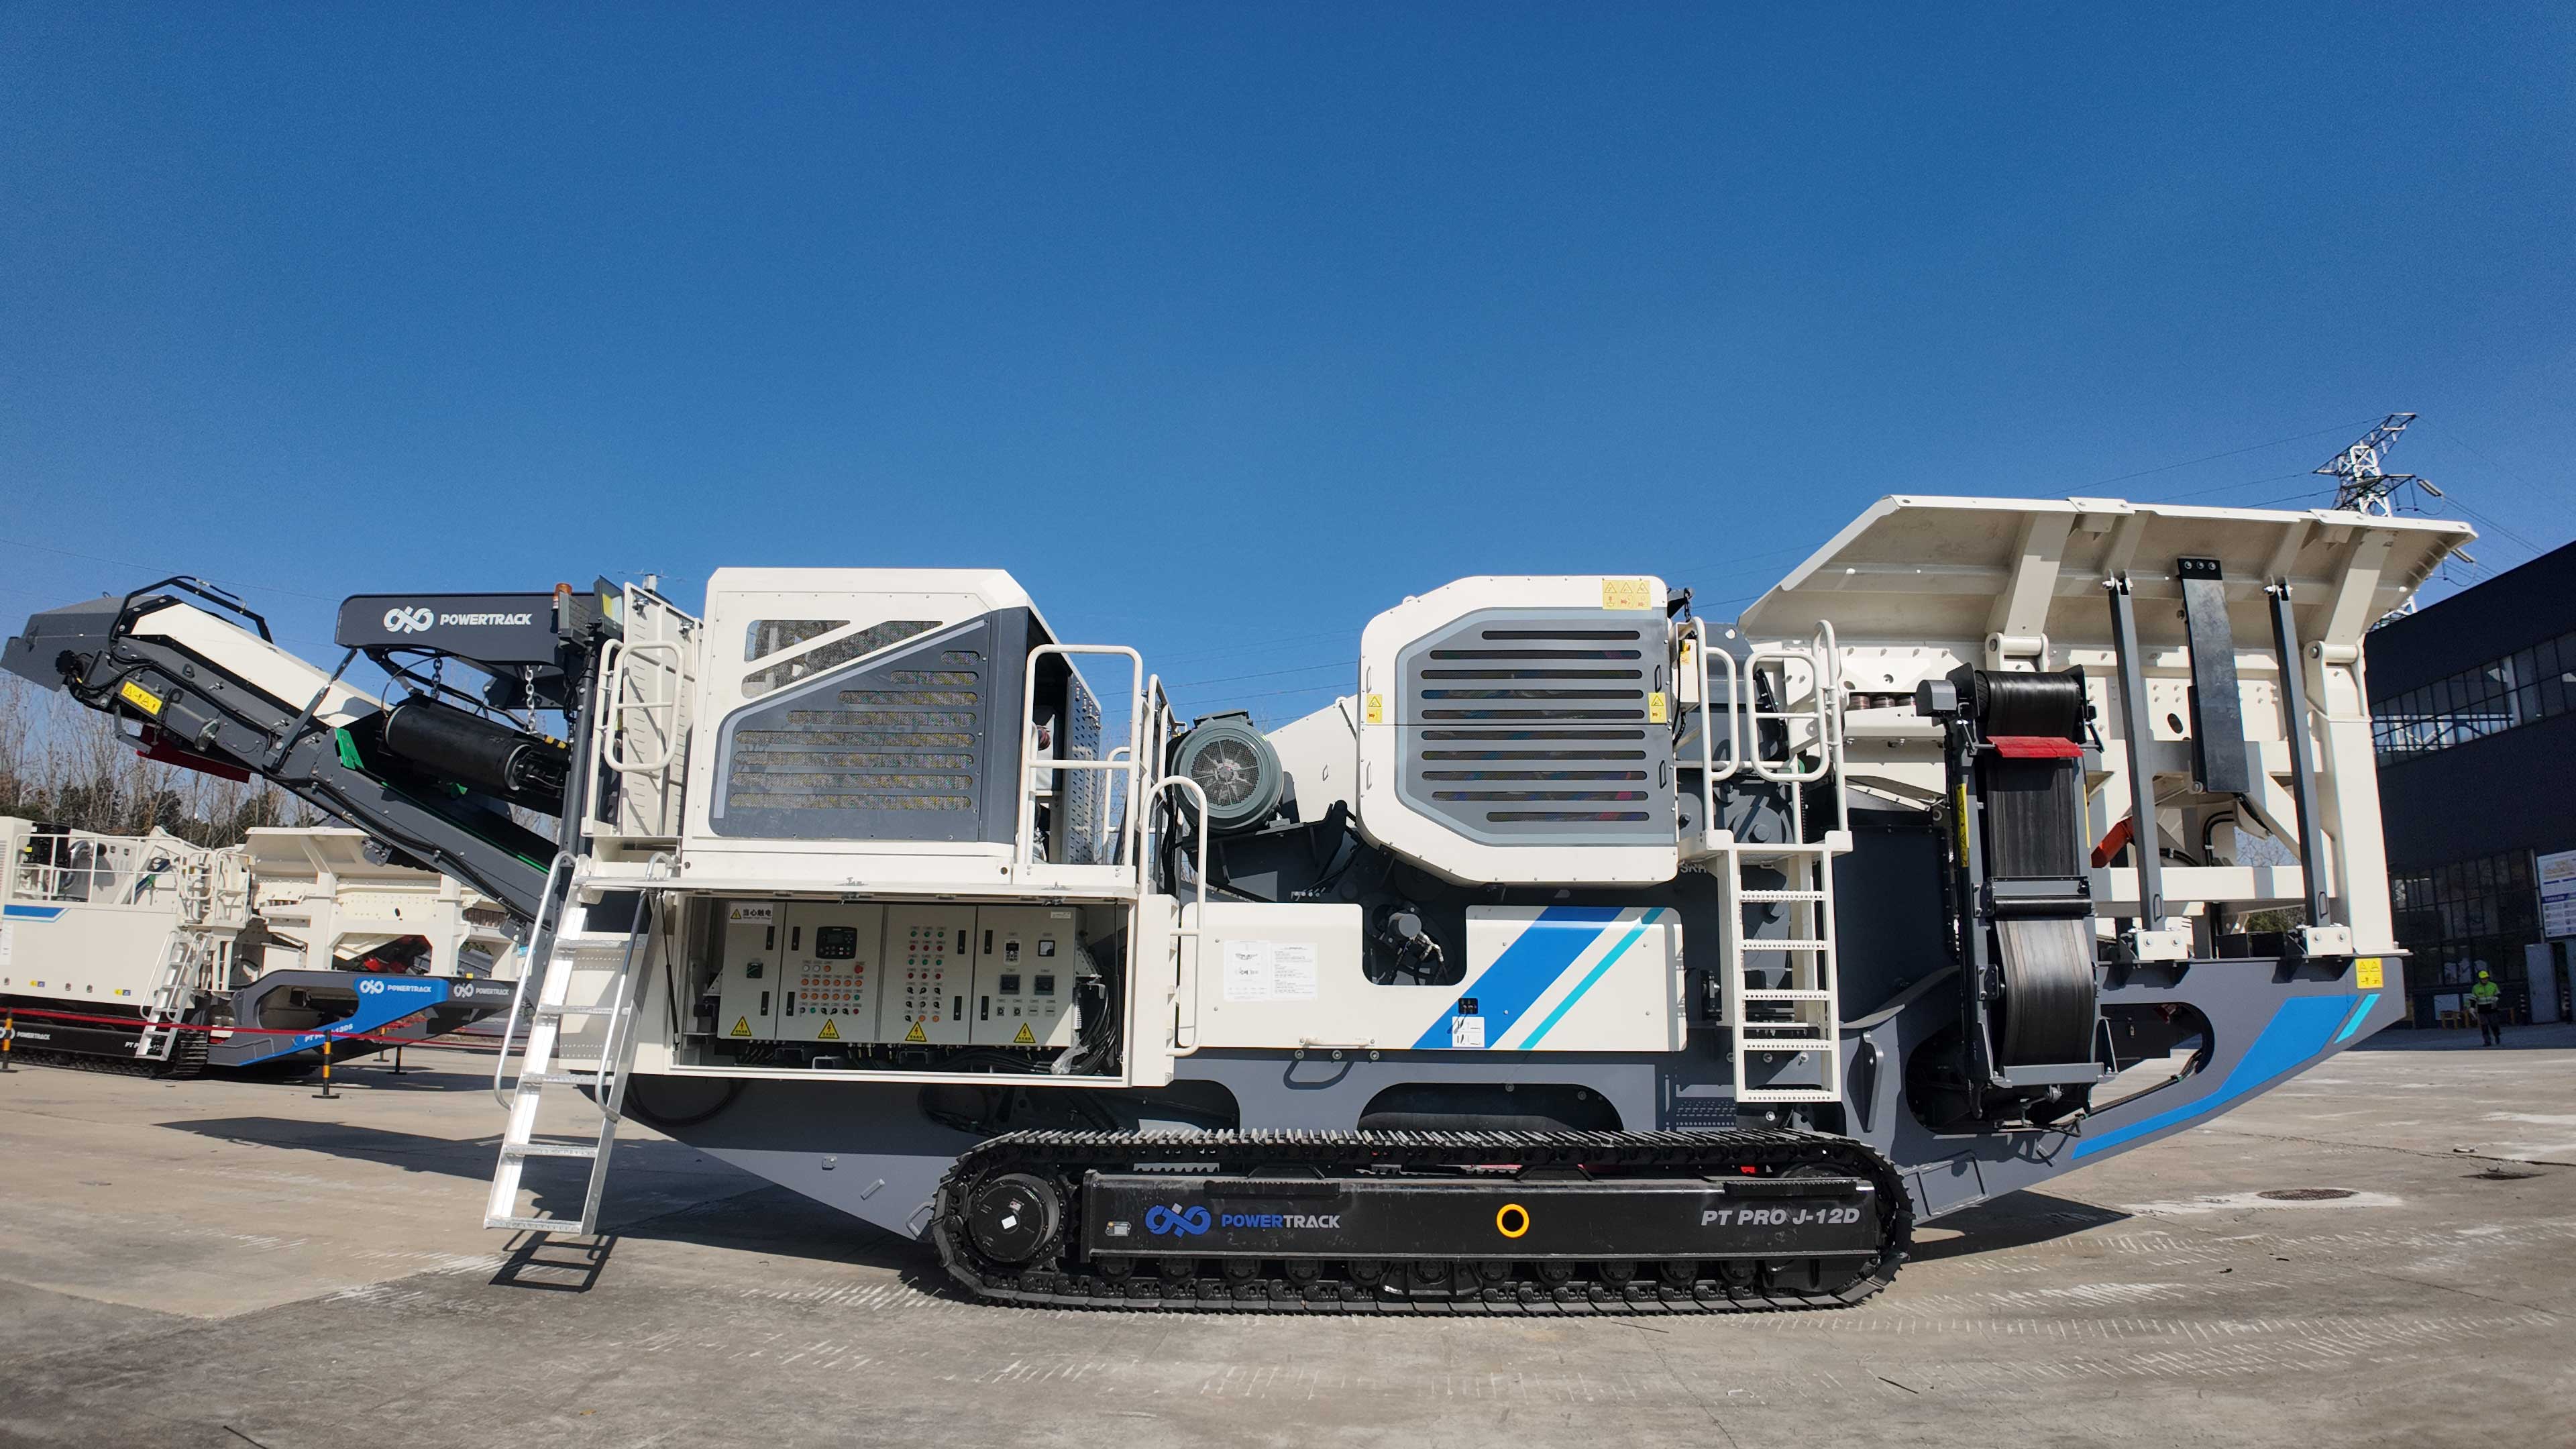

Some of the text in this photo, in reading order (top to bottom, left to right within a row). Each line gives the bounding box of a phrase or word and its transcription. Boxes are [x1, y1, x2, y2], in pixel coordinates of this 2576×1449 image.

[439, 613, 533, 625] POWERTRACK
[387, 984, 432, 993] POWERTRACK
[475, 987, 509, 996] POWERTRACK
[16, 1031, 51, 1040] POWERTRACK
[1221, 1214, 1340, 1228] POWERTRACK
[1701, 1208, 1860, 1226] PT PRO J-12D
